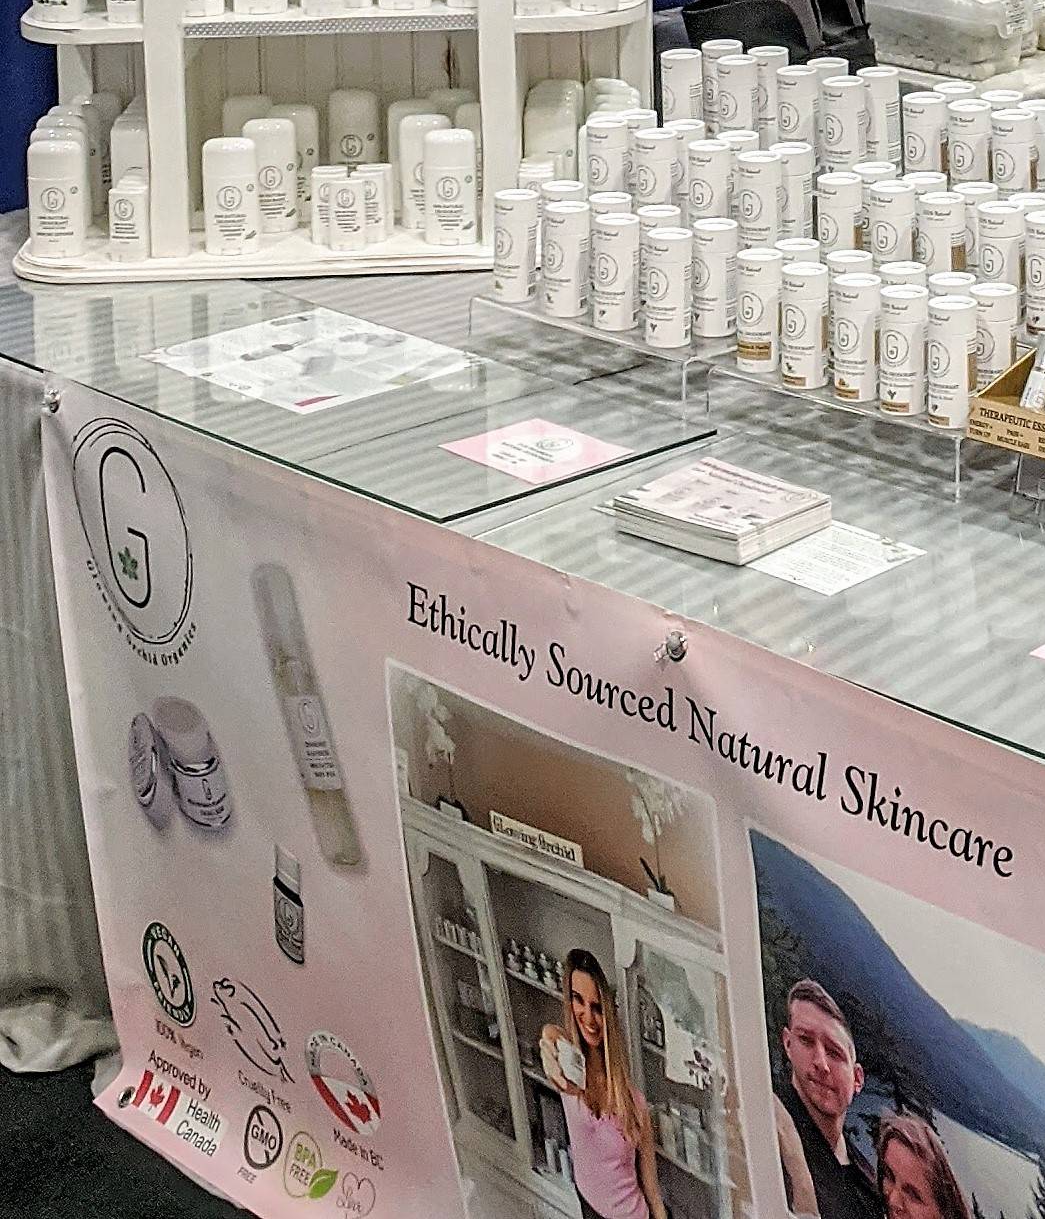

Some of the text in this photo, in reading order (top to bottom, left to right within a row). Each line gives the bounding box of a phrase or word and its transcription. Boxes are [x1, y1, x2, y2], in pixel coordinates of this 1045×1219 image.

[979, 407, 1032, 429] THERAPEUTIC
[406, 581, 1014, 877] Ethically Sourced Natural Skincare
[148, 1049, 212, 1101] Approved by
[186, 1100, 221, 1132] Health
[176, 1120, 218, 1158] Canada
[251, 1124, 277, 1151] GMO
